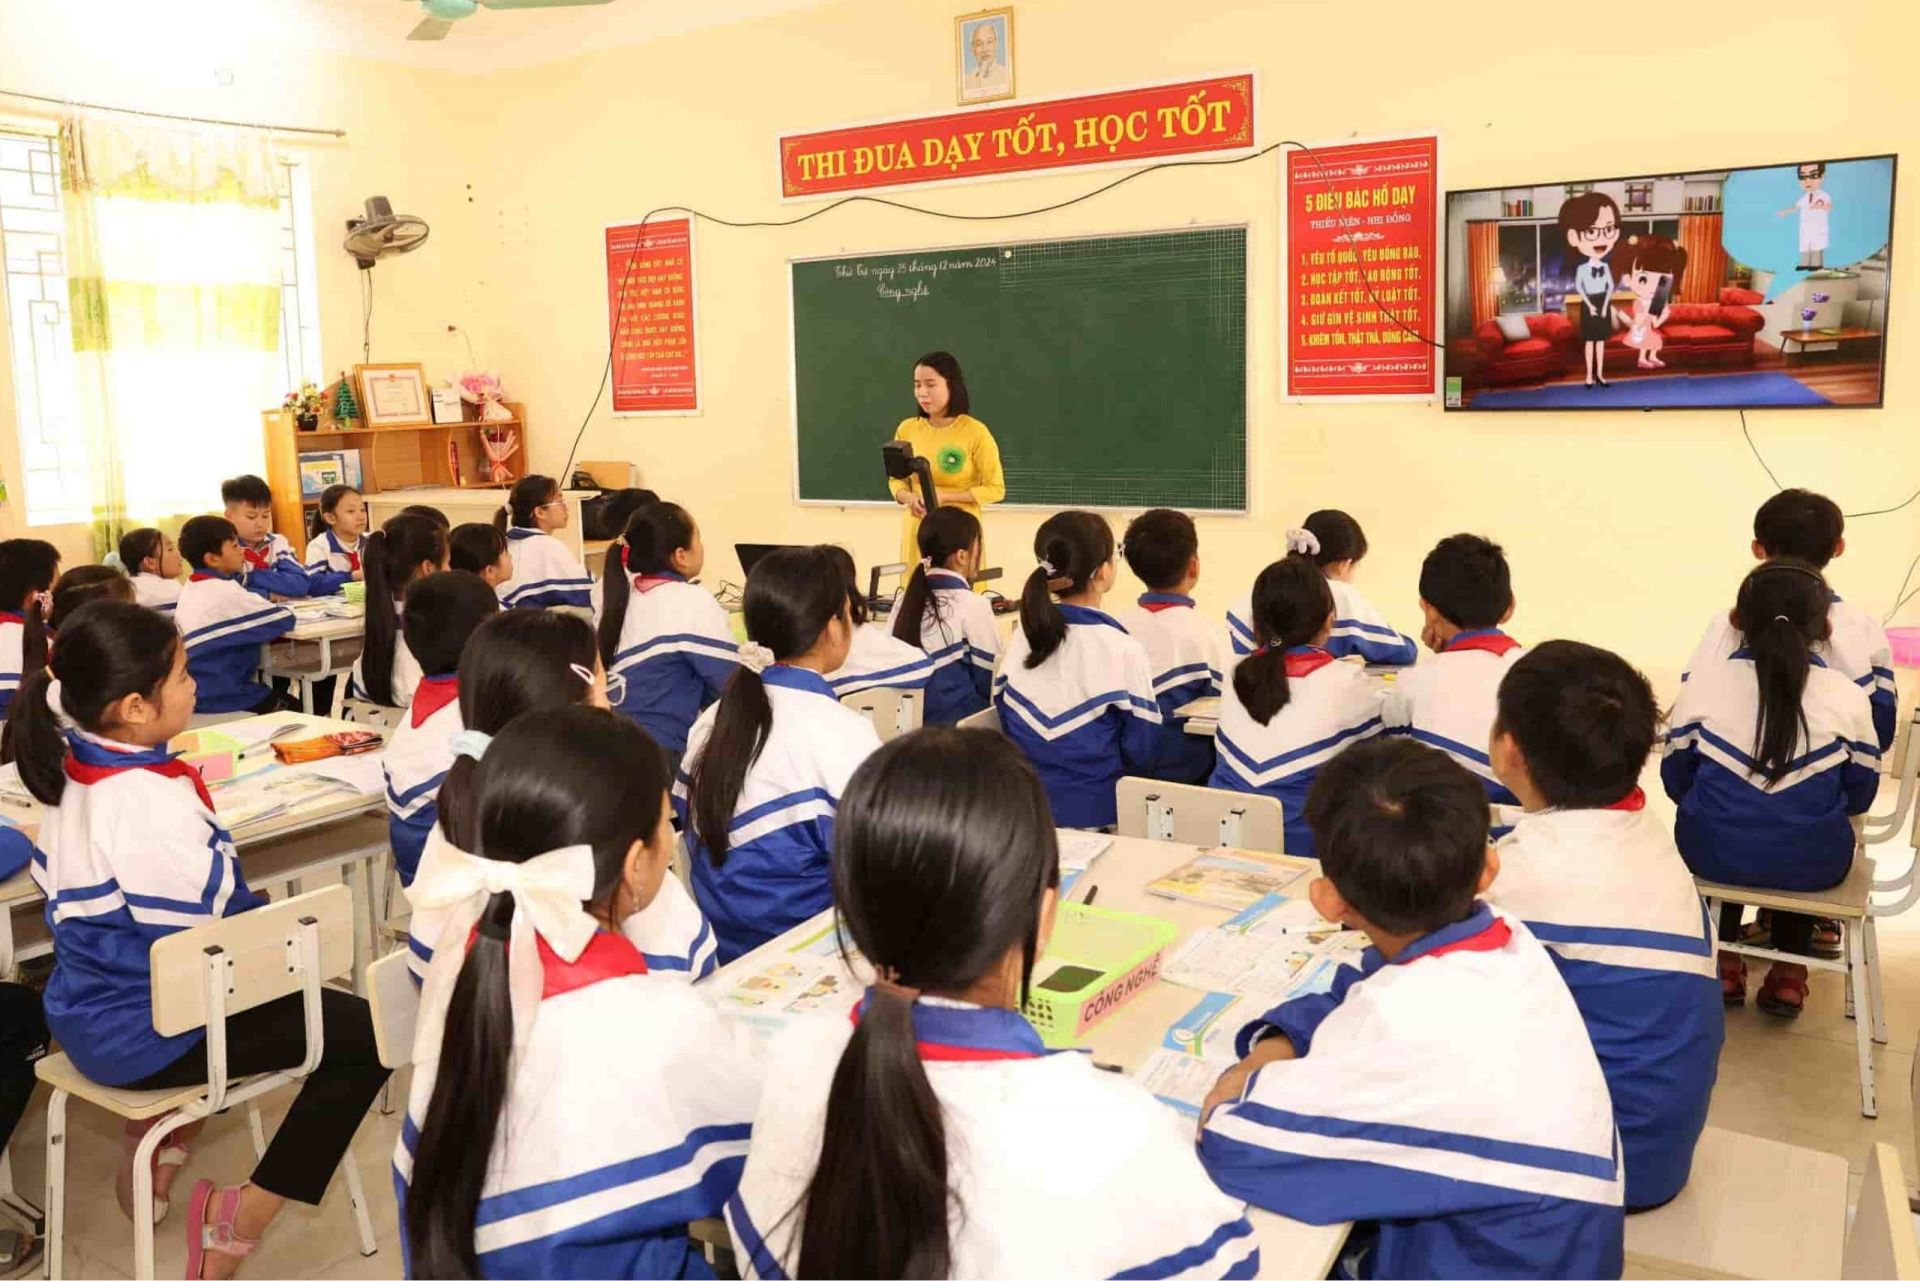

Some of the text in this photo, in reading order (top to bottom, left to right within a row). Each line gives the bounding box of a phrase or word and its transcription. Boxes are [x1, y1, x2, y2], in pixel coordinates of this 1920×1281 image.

[797, 90, 1231, 181] THI ĐUA DẠY TỐT, HỌC TỐT
[1305, 194, 1313, 213] 5
[1346, 185, 1369, 209] BÁC
[1392, 185, 1416, 209] DẠY
[871, 264, 896, 281] ngày
[897, 262, 907, 274] 25
[908, 258, 938, 279] tháng
[940, 259, 948, 270] 12
[949, 260, 974, 270] năm
[974, 256, 997, 268] 2024
[876, 281, 901, 303] Công
[1084, 983, 1123, 1022] CÔNG
